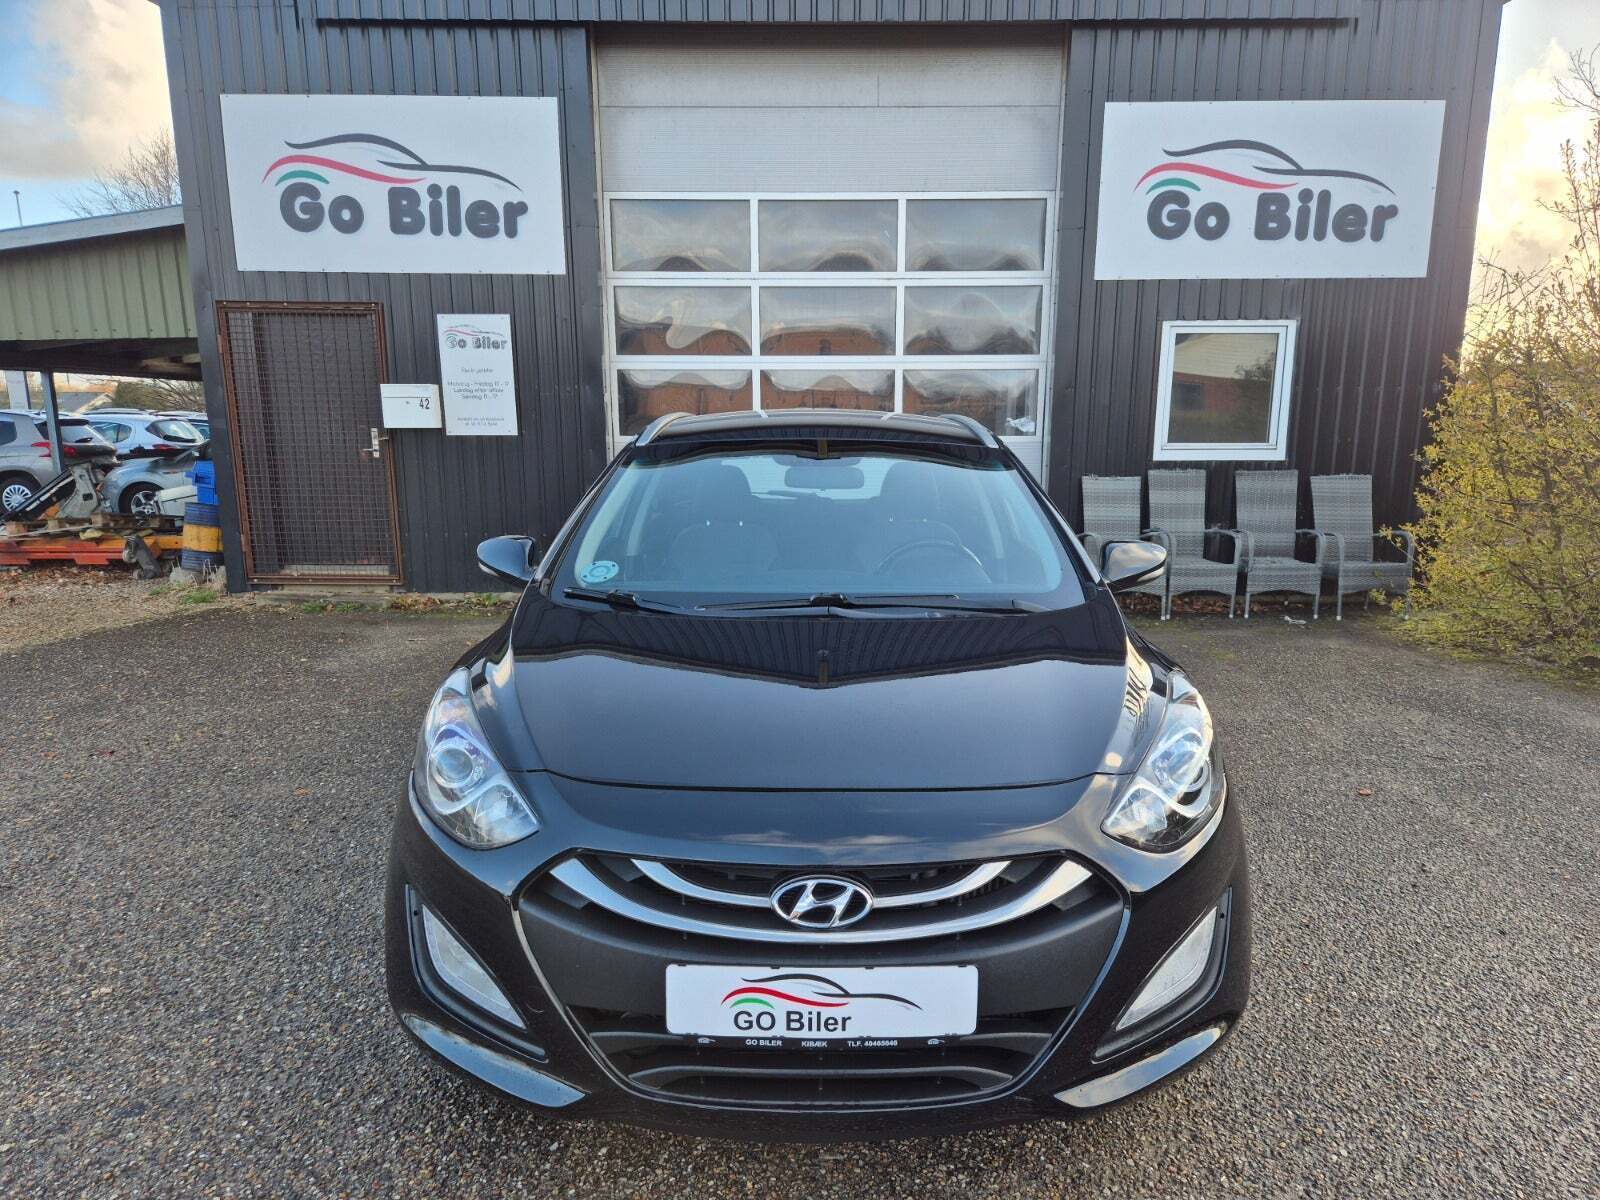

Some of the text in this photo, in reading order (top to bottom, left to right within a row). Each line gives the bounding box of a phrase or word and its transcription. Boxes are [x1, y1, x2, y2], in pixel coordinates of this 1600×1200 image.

[279, 181, 529, 239] Go Biler
[1146, 187, 1399, 243] Go Biler
[472, 335, 508, 350] Biler
[419, 398, 430, 410] 42
[733, 1010, 851, 1032] GO Biler
[759, 1039, 783, 1047] BILER
